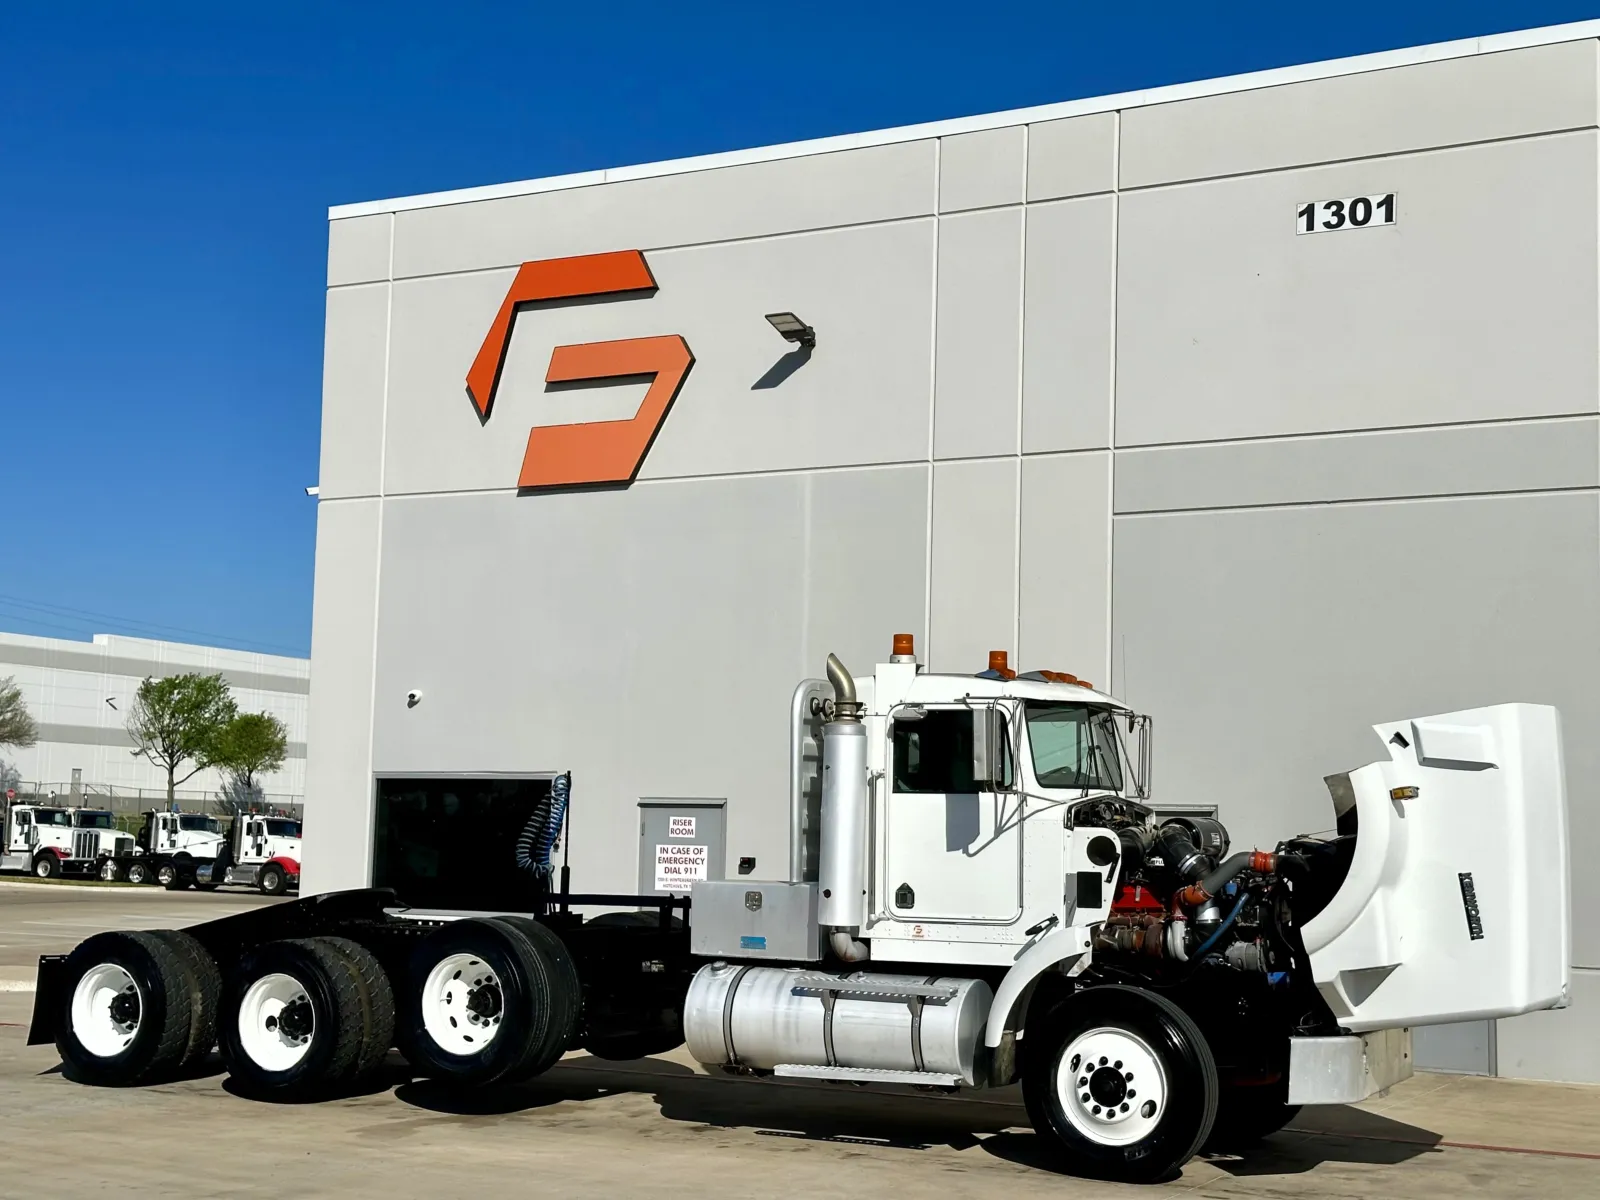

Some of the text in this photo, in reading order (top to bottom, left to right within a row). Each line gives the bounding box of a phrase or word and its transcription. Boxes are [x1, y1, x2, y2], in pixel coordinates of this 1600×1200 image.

[1298, 193, 1395, 232] 1301
[672, 819, 693, 827] RISER
[670, 828, 694, 836] ROOM
[659, 847, 704, 855] IN CASE OF
[657, 856, 705, 865] EMERGENCY
[664, 866, 697, 875] DIAL 911
[1458, 872, 1484, 941] KENWORTH
